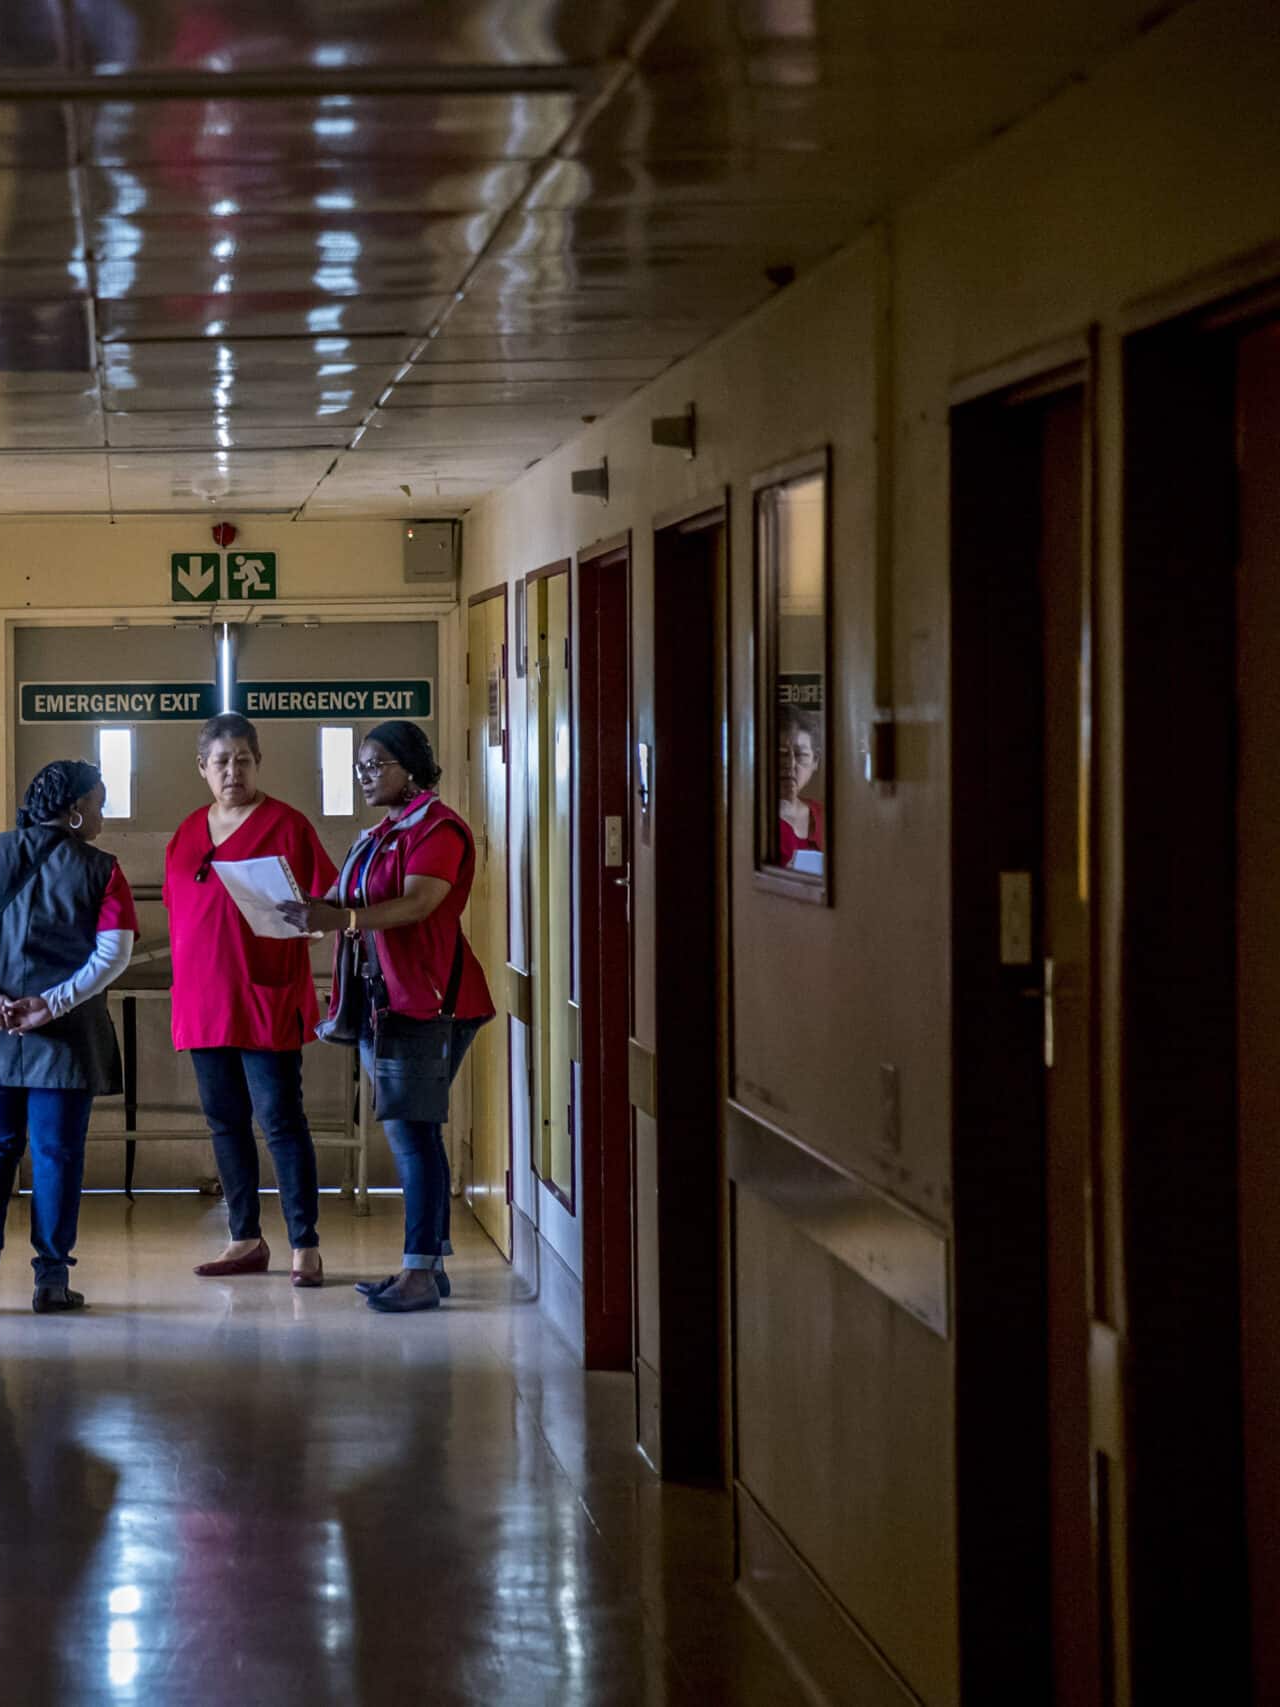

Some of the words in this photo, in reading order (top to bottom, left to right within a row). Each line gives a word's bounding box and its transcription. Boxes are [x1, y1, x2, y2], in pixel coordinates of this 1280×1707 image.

[34, 693, 155, 713] EMERGENCY
[159, 693, 201, 712] EXIT
[247, 691, 368, 711] EMERGENCY
[372, 691, 414, 710] EXIT
